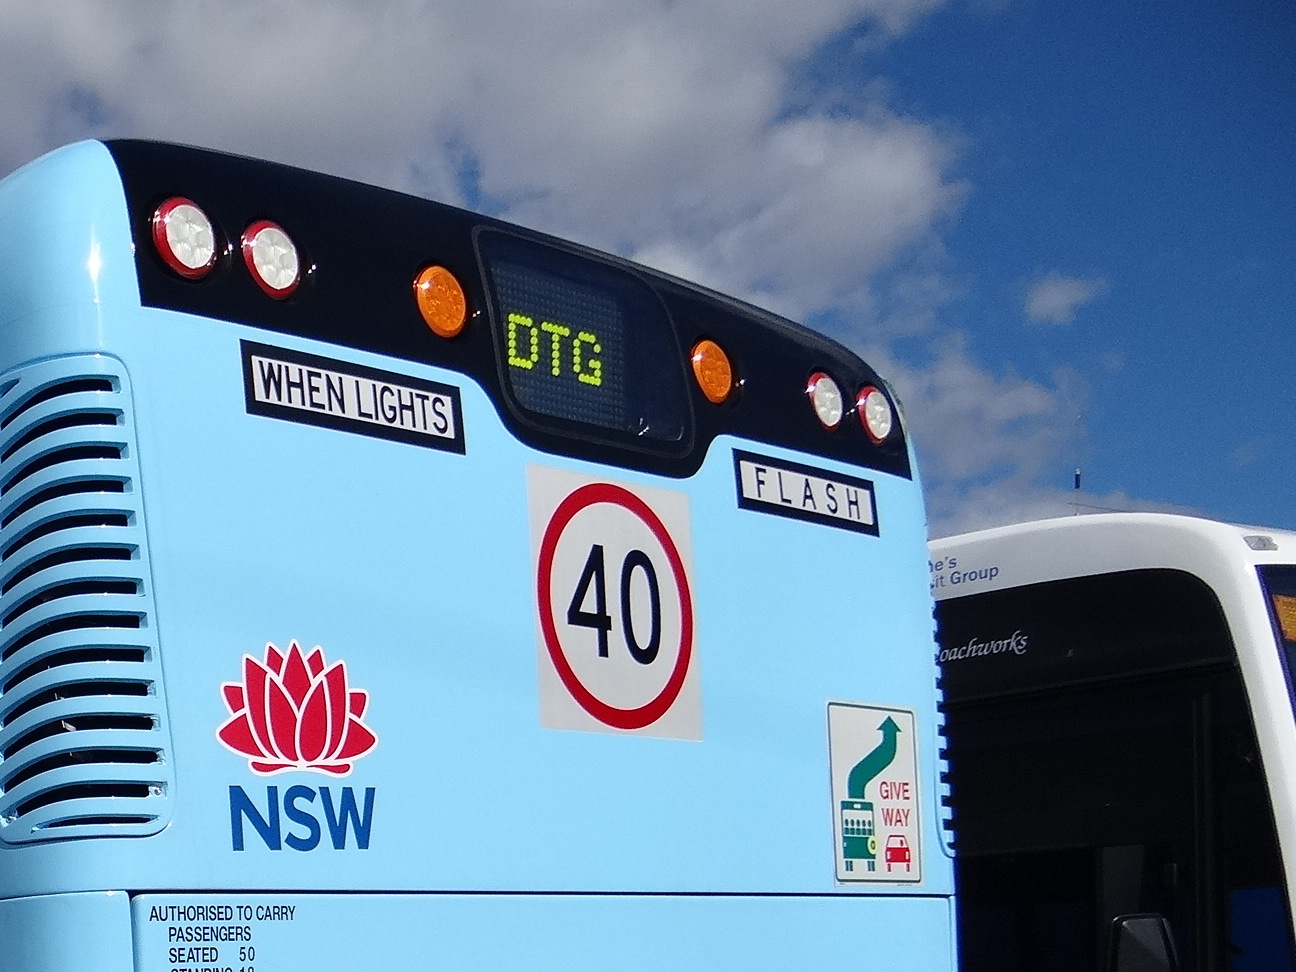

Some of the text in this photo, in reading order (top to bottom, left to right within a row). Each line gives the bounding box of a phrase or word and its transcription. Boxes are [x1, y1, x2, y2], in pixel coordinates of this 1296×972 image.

[508, 313, 602, 386] DTG
[258, 360, 449, 435] WHEN LIGHTS
[755, 466, 861, 520] FLASH
[950, 566, 999, 585] Group
[566, 542, 661, 666] 40
[937, 629, 1028, 662] oachworks
[879, 781, 910, 800] GIVE
[229, 784, 376, 852] NSW
[881, 808, 910, 827] WAY
[149, 905, 295, 921] AUTHORISED TO CARRY
[168, 926, 251, 942] PASSENGERS
[168, 946, 255, 963] SEATED 50
